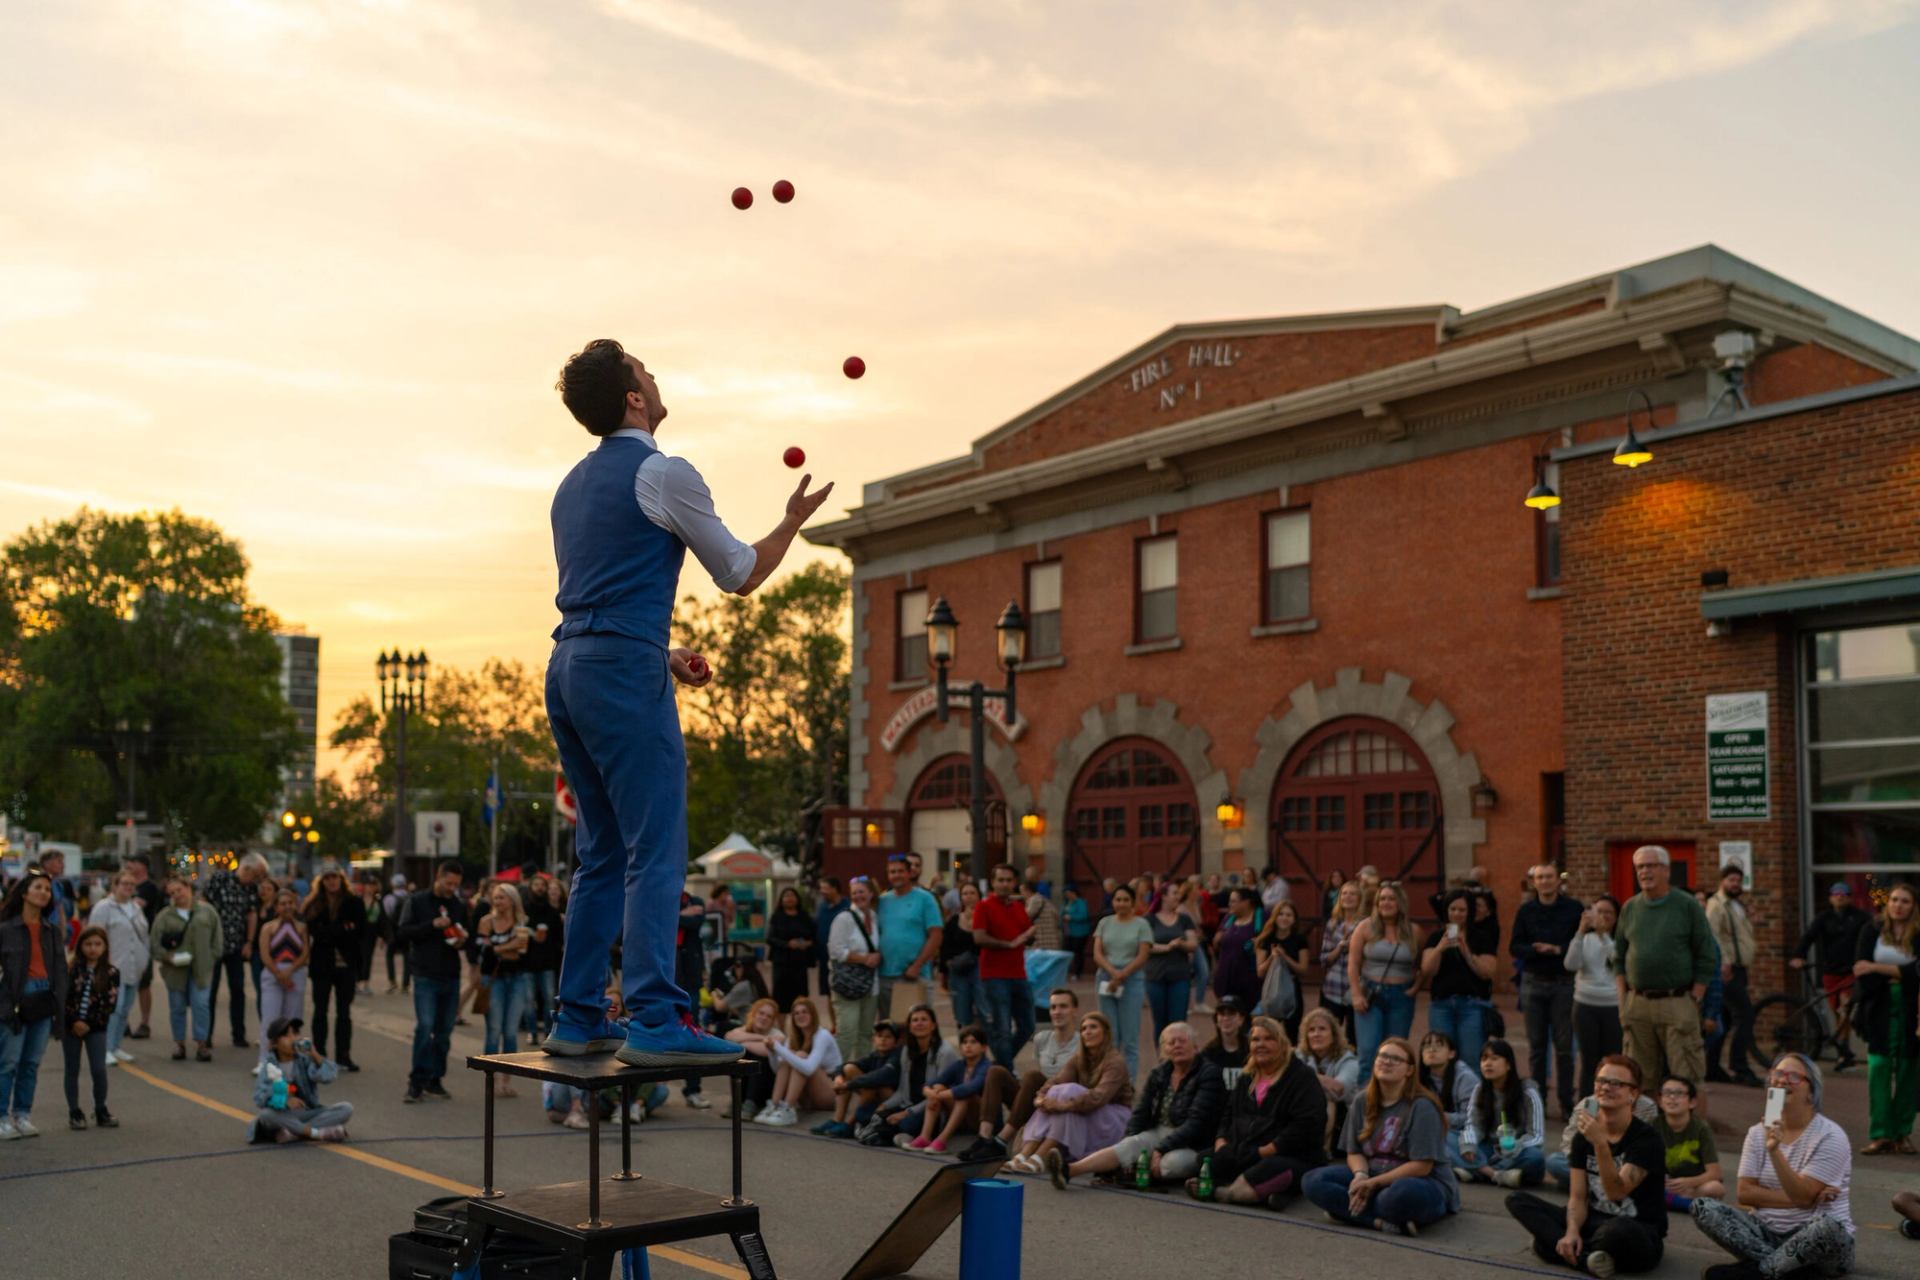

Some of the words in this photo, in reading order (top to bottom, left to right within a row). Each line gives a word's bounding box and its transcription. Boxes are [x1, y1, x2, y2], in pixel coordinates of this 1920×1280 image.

[1131, 356, 1173, 392] FIRE
[1188, 343, 1232, 367] HALL
[1723, 733, 1750, 744] OPEN
[1709, 747, 1731, 757] YEAR
[1732, 745, 1765, 756] ROUND
[1712, 763, 1763, 775] SATURDAYS
